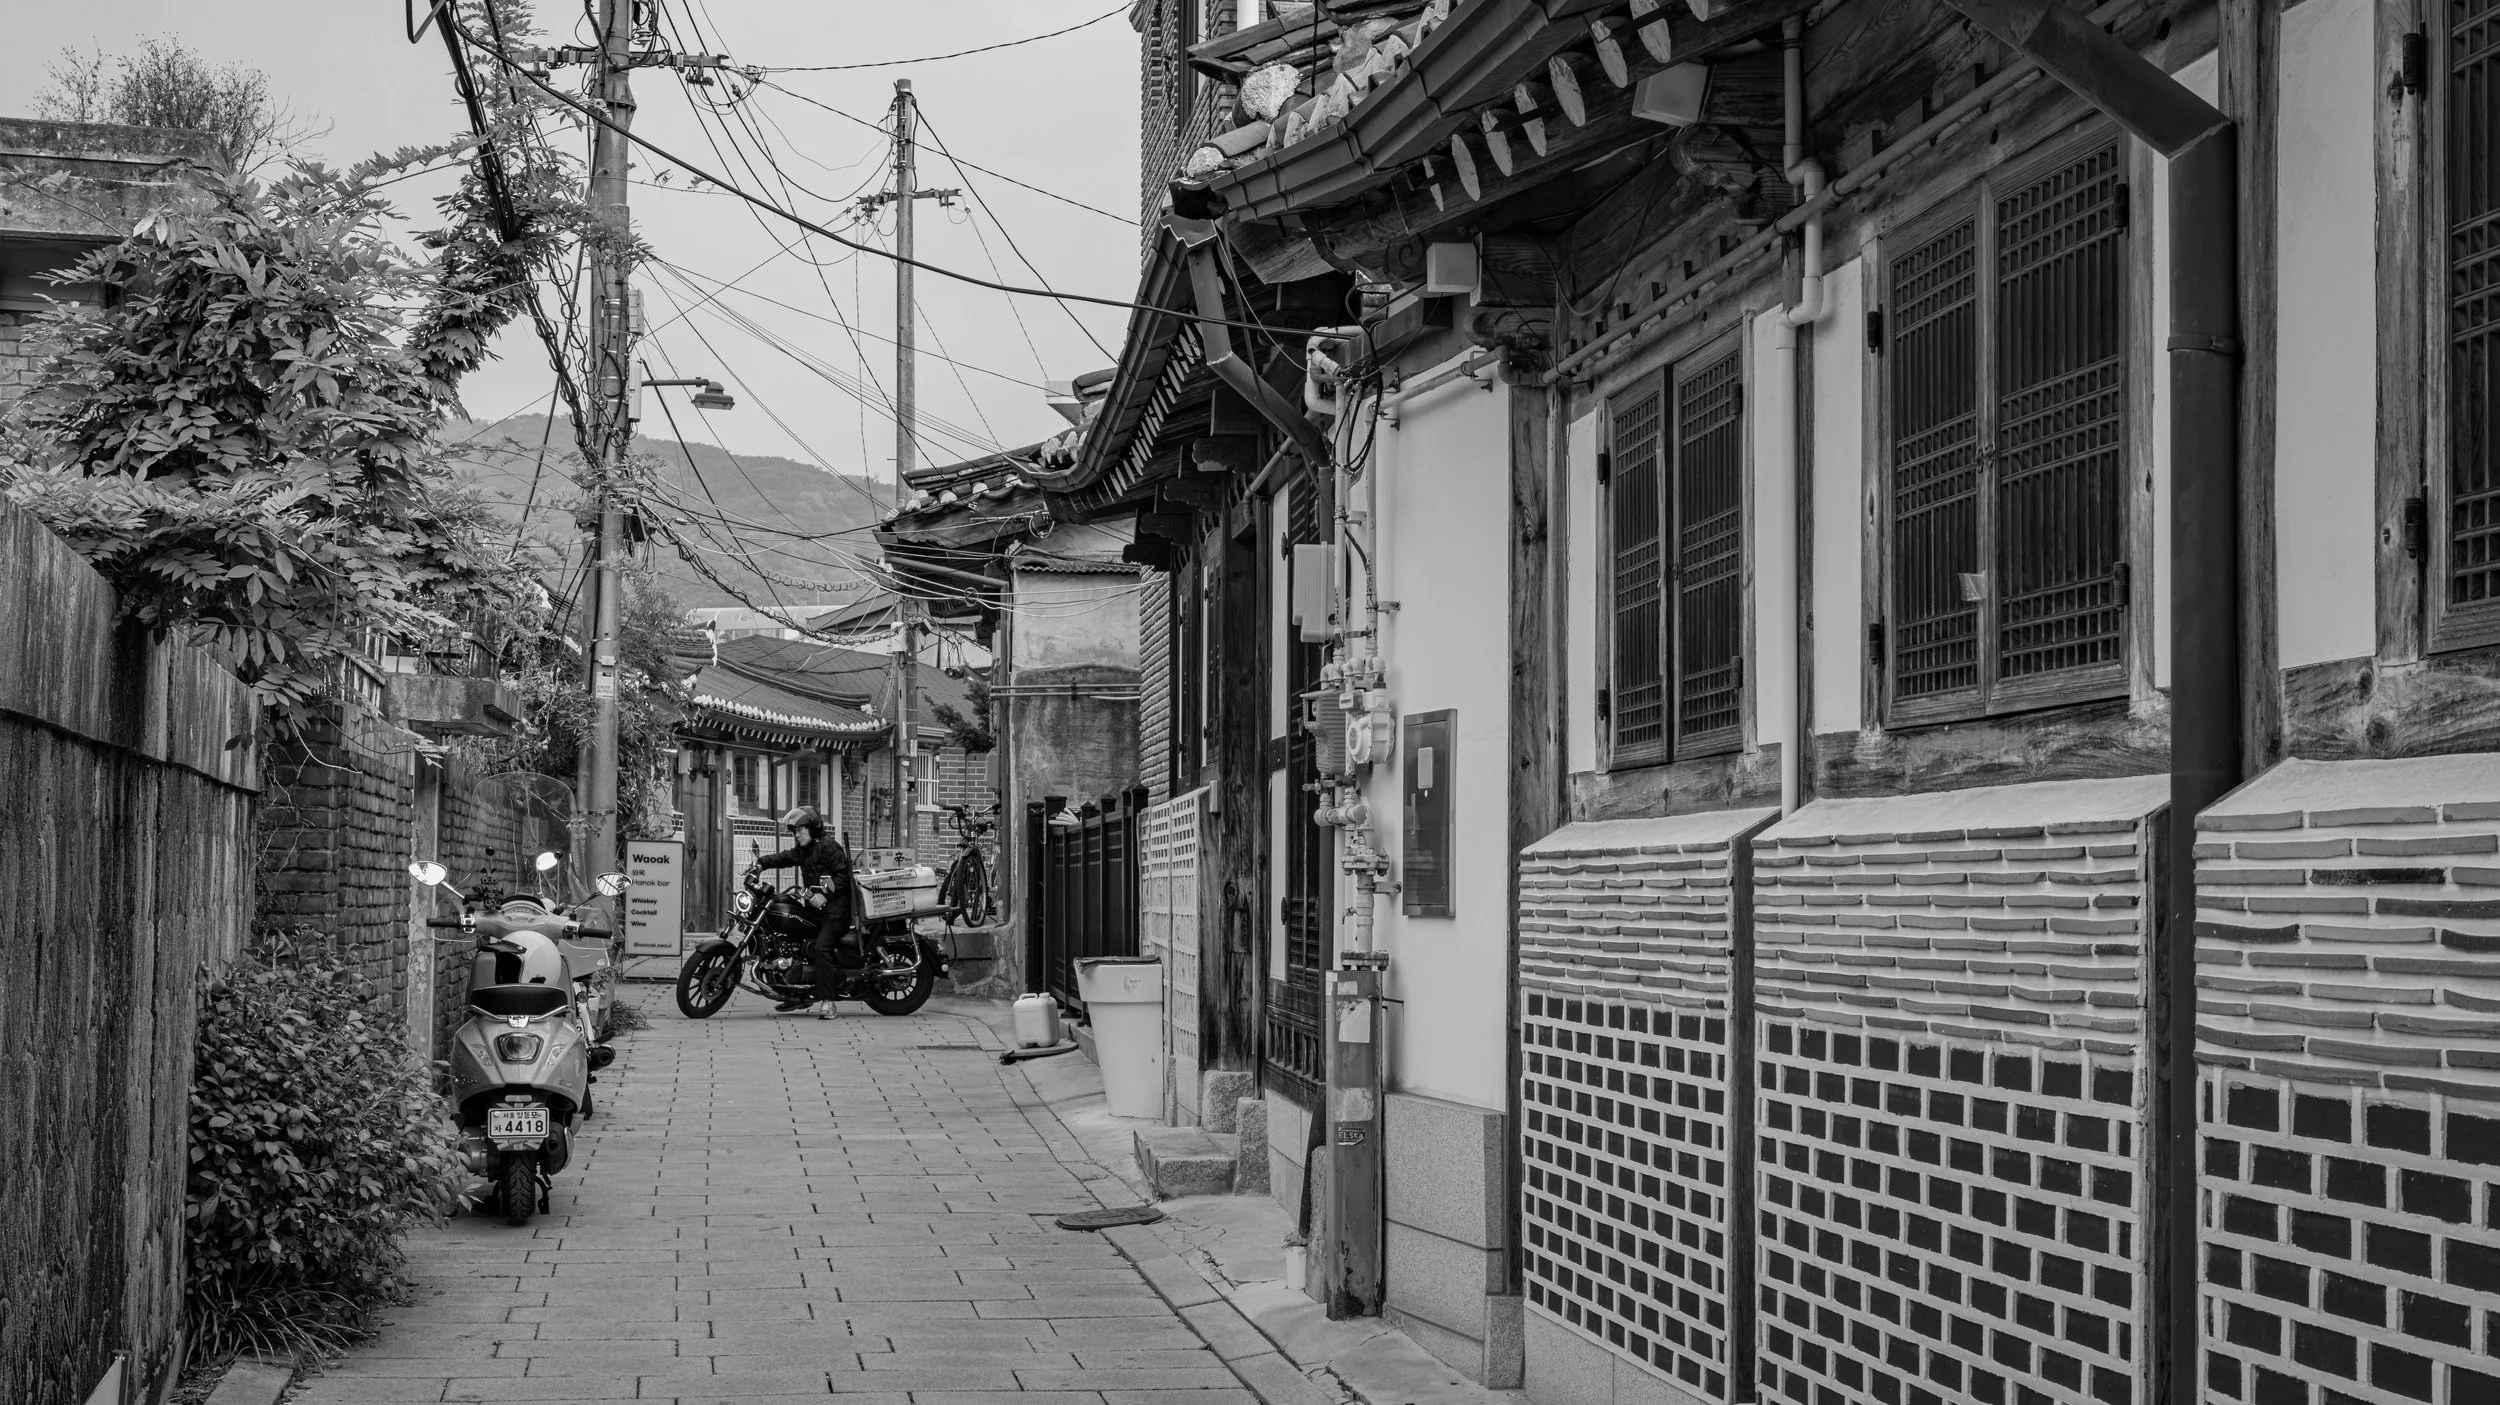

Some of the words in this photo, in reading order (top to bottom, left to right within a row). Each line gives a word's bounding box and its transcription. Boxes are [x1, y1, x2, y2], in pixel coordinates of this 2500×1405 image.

[632, 854, 670, 864] Waoak
[631, 897, 657, 905] Whiskey
[505, 1120, 544, 1133] 4418
[1338, 1131, 1364, 1139] ELSKA
